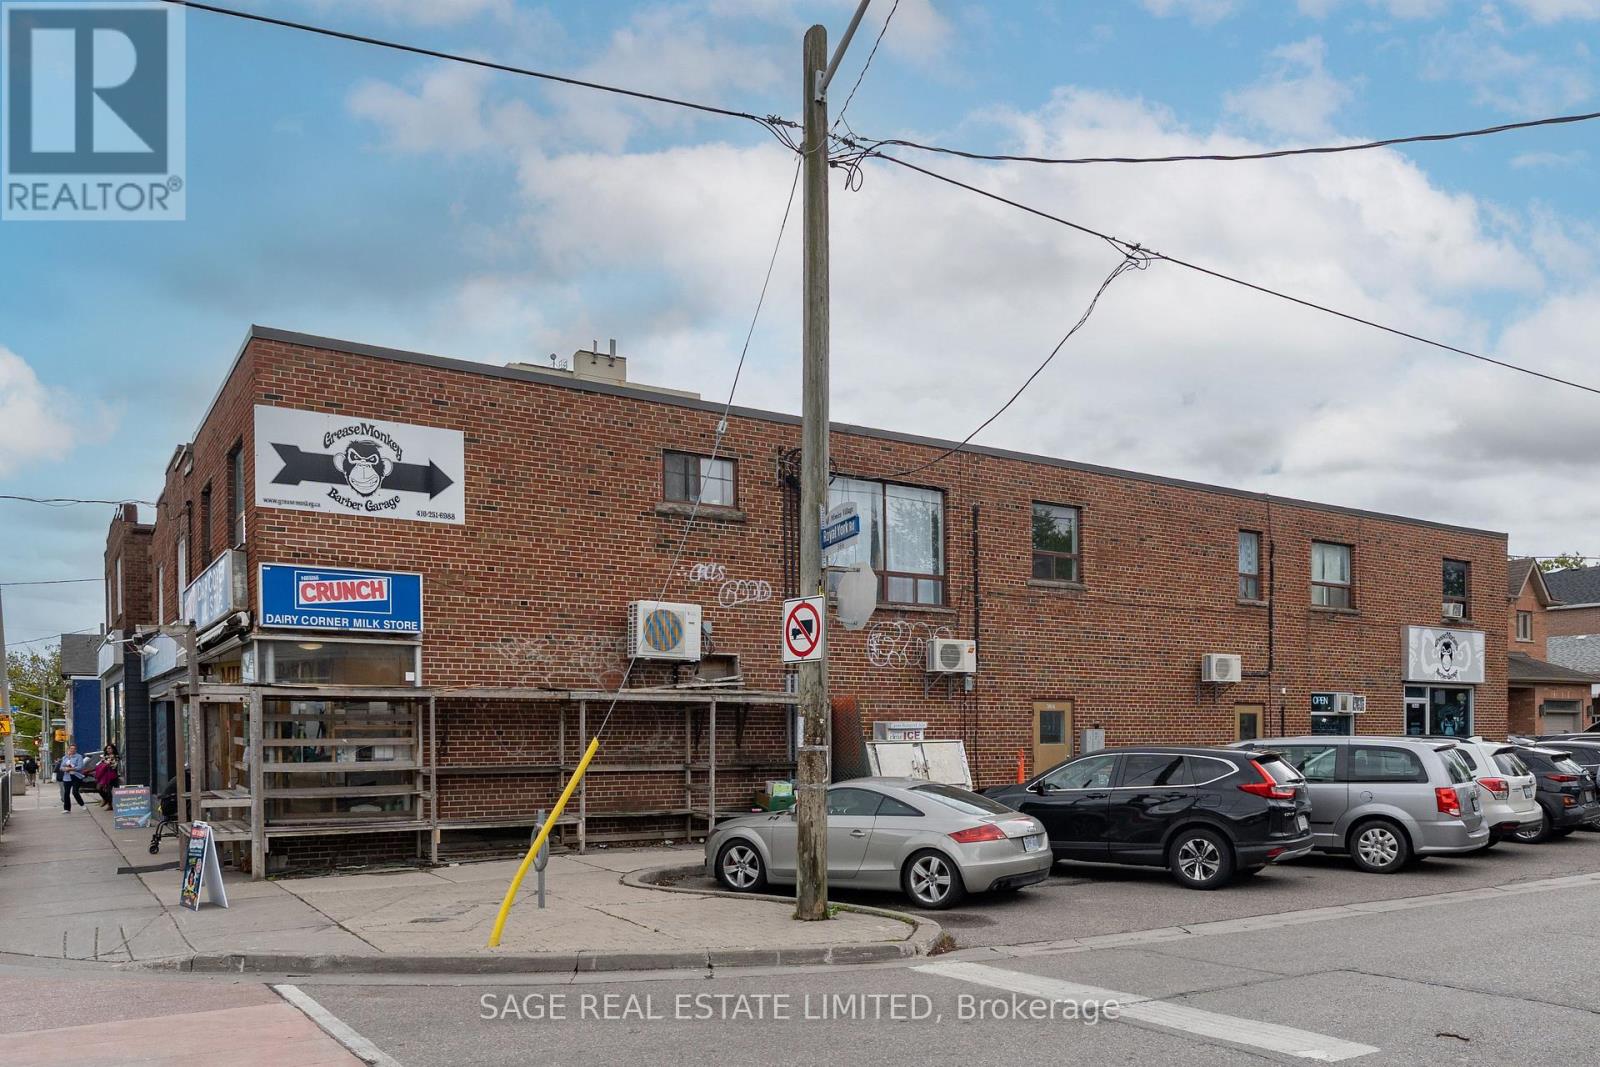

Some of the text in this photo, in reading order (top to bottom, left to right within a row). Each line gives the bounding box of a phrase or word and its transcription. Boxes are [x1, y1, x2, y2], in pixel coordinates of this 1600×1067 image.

[327, 485, 401, 512] Barber Garage
[300, 580, 385, 602] CRUNCH
[266, 613, 418, 631] DAIRY CORNER MILK STORE
[1312, 696, 1329, 705] OPEN
[903, 731, 921, 740] ICE
